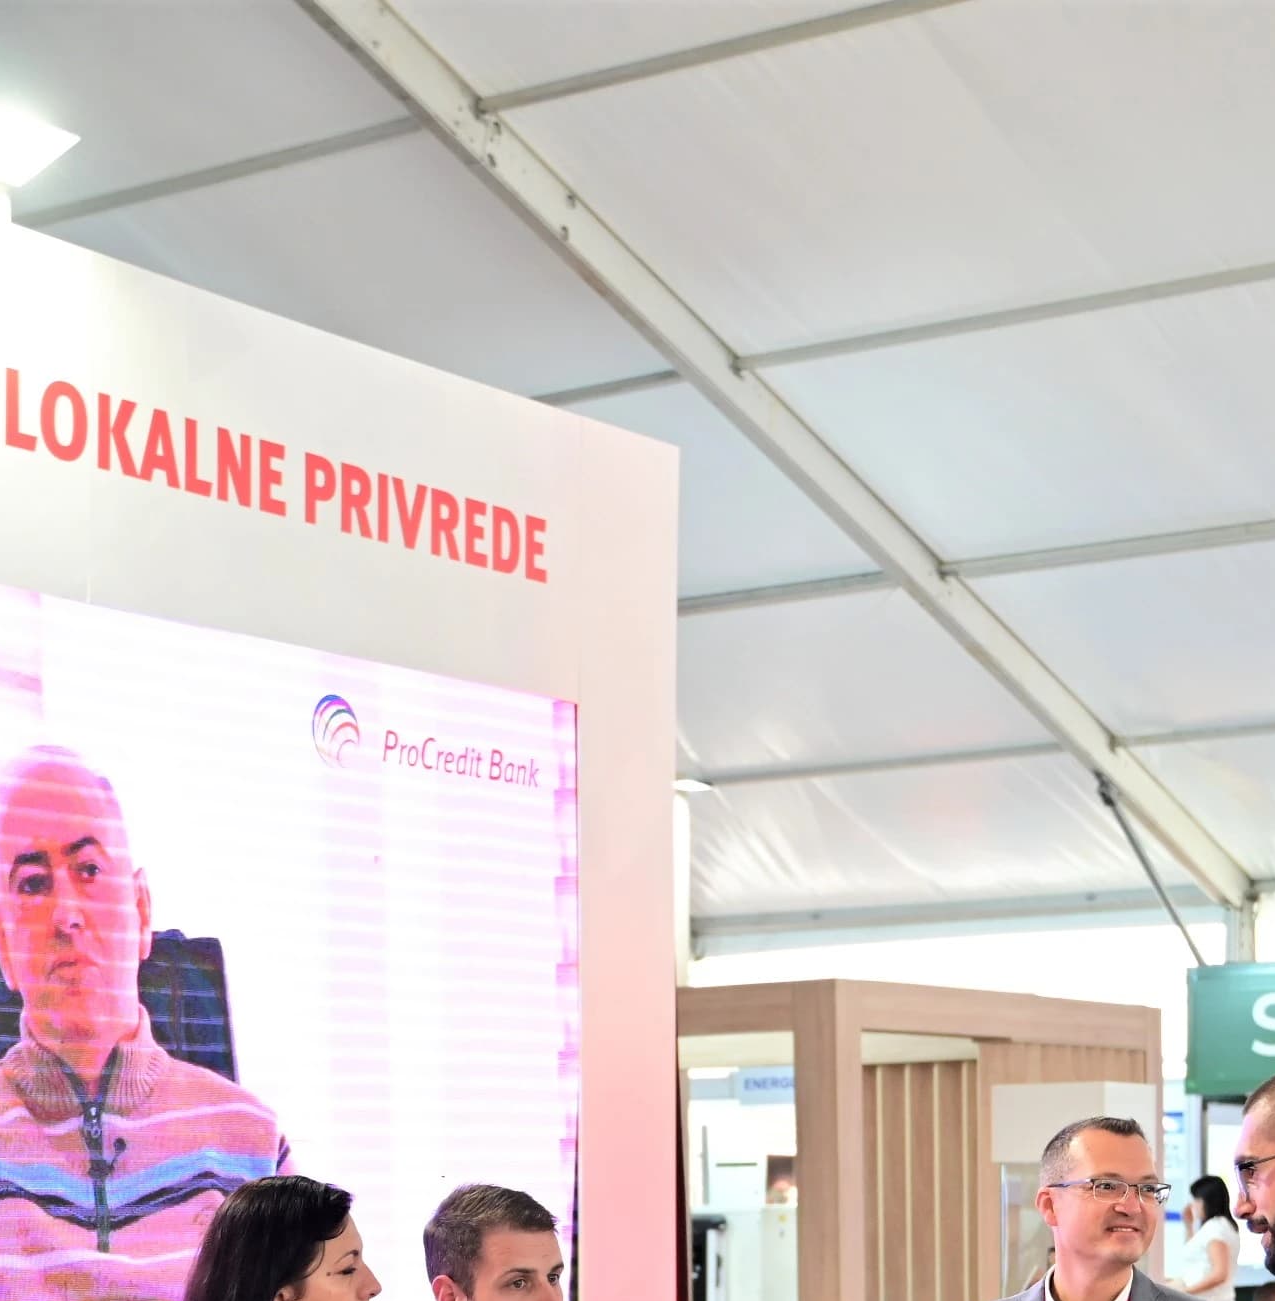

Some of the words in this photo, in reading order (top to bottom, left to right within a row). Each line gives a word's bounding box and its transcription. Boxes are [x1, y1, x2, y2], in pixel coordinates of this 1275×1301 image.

[5, 368, 287, 518] LOKALNE
[304, 451, 548, 584] PRIVREDE
[383, 730, 482, 778] ProCredit
[489, 749, 540, 788] Bank
